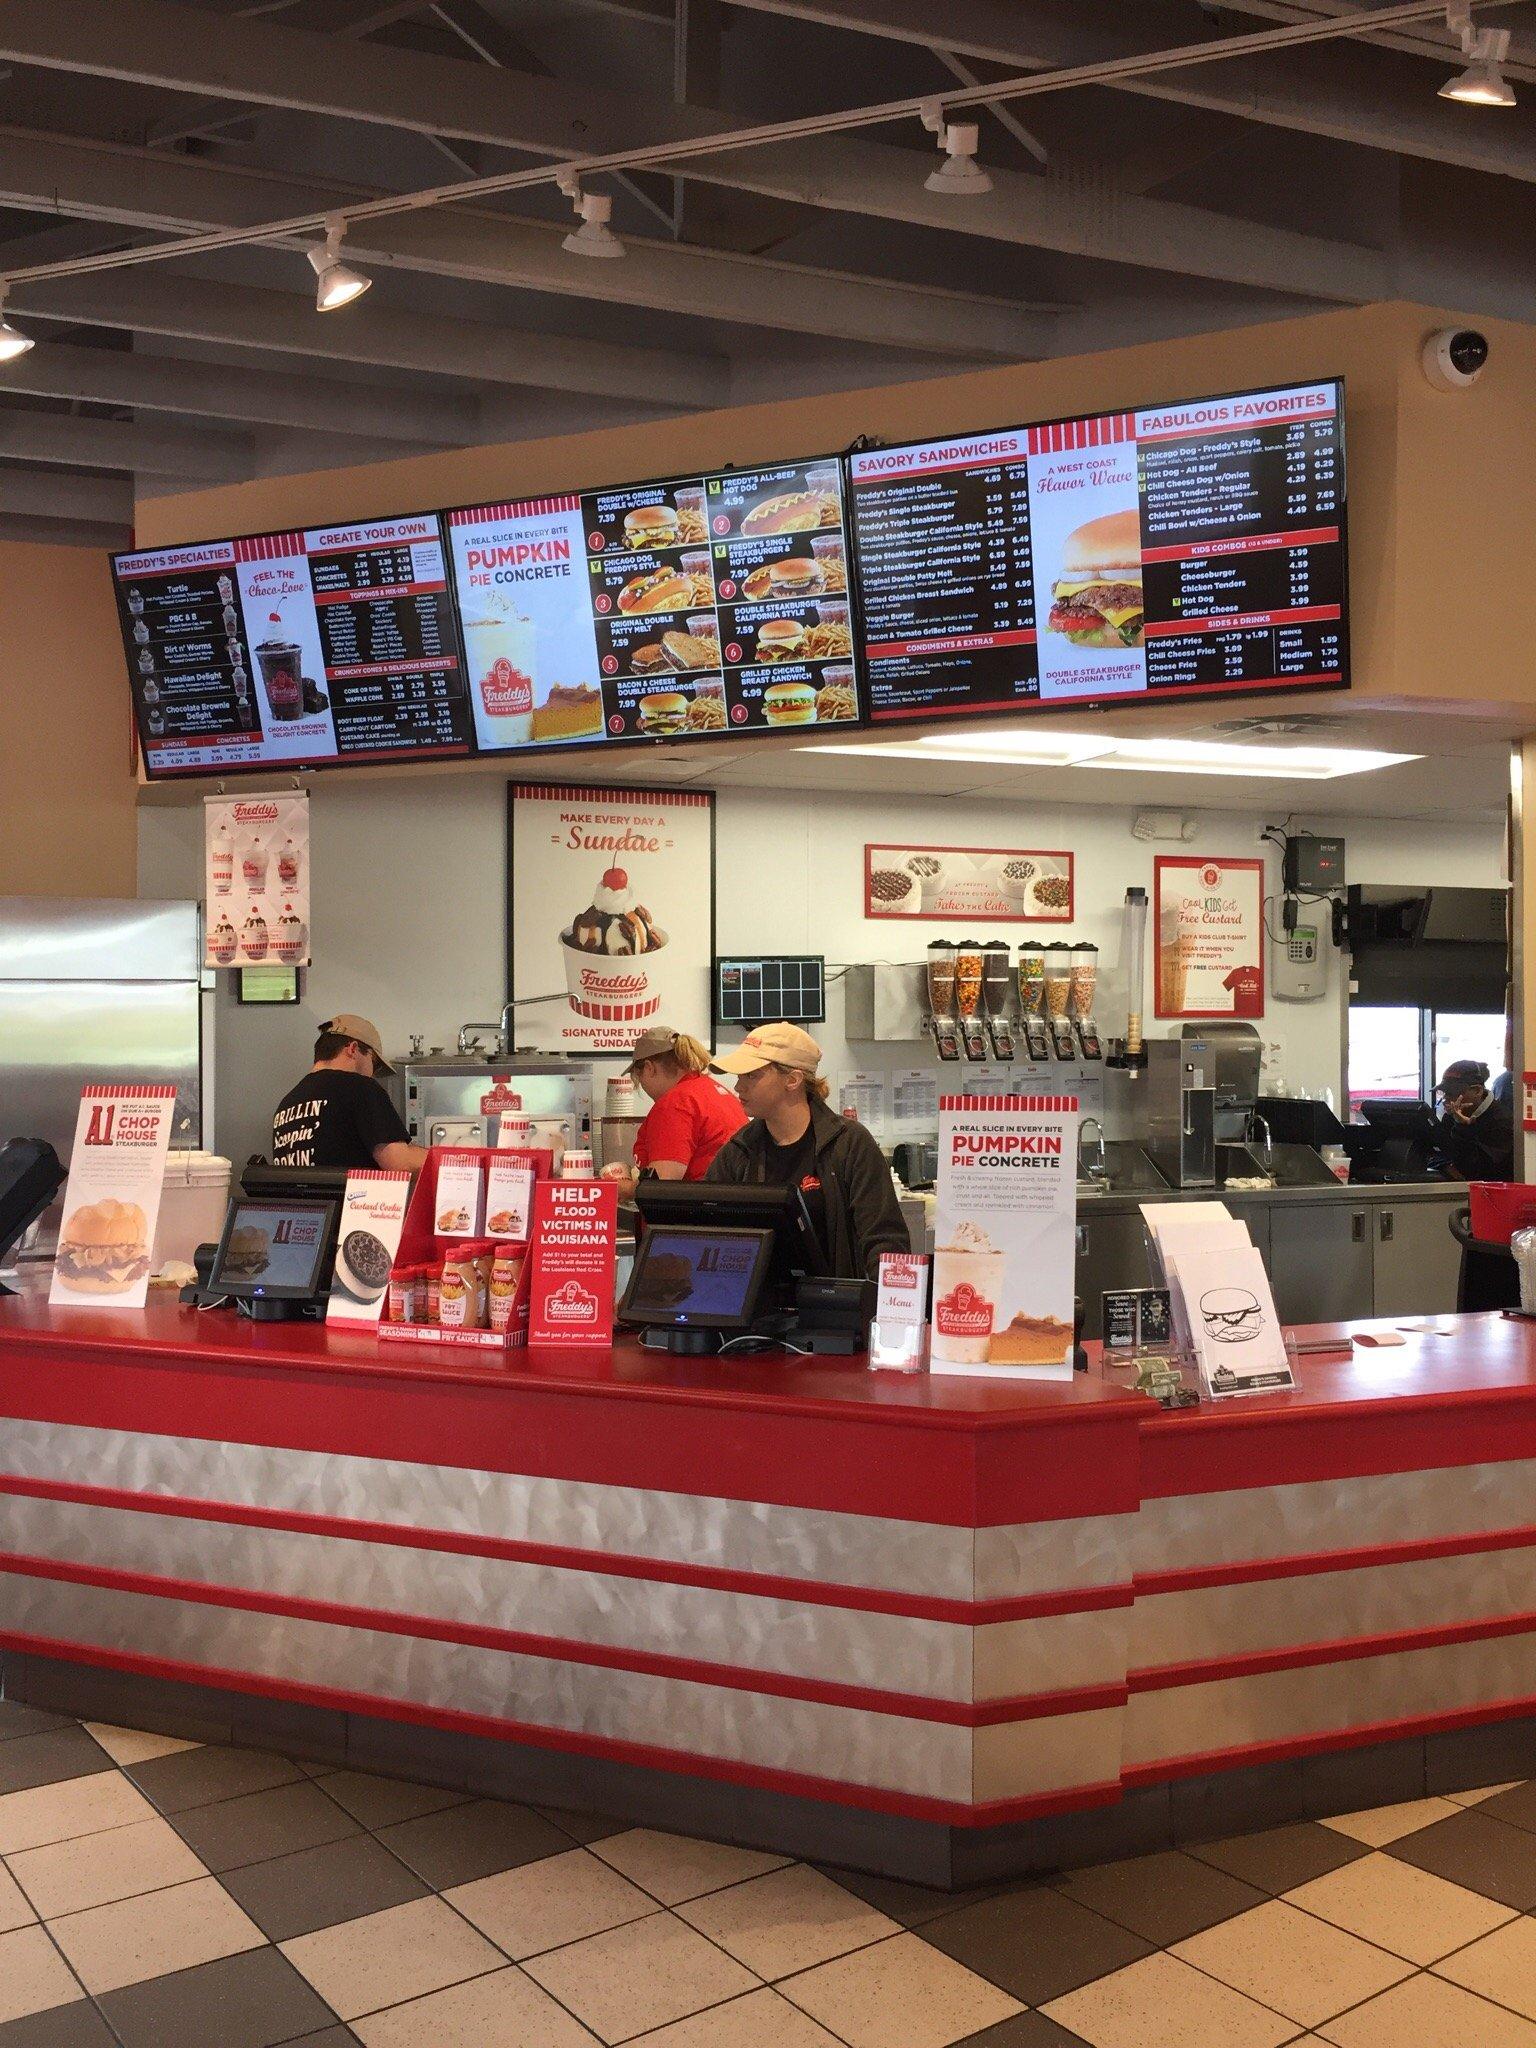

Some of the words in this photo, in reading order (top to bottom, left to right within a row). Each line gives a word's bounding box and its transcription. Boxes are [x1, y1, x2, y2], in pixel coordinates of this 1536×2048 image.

[1142, 406, 1229, 431] FABULOUS
[1234, 392, 1326, 417] FAVORITES
[858, 453, 914, 472] SAVORY
[918, 438, 1017, 464] SANDWICHES
[1057, 463, 1082, 473] WEST
[1086, 458, 1116, 469] COAST
[722, 476, 758, 487] FREDDY'S
[759, 470, 795, 482] ALL-BEEF
[1036, 473, 1084, 493] Flavor
[1089, 466, 1132, 486] Wave
[723, 486, 738, 494] HOT
[740, 483, 757, 492] DOG
[856, 490, 886, 501] Freddy's
[887, 486, 915, 496] Original
[916, 482, 941, 492] Double
[596, 493, 630, 504] FREDDY'S
[632, 489, 666, 500] ORIGINAL
[724, 496, 744, 506] 4.99
[597, 501, 626, 511] DOUBLE
[628, 496, 663, 508] w/CHEESE
[857, 509, 887, 520] Freddy's
[888, 506, 910, 516] Single
[911, 500, 955, 513] Steakburger
[319, 531, 362, 545] CREATE
[364, 526, 395, 539] YOUR
[398, 522, 426, 535] OWN
[471, 536, 490, 545] REAL
[492, 533, 513, 542] SLICE
[523, 528, 549, 538] EVERY
[550, 525, 568, 534] BITE
[118, 556, 165, 571] FREDDY'S
[167, 548, 230, 565] SPECIALTIES
[466, 538, 570, 571] PUMPKIN
[603, 556, 634, 566] CHICAGO
[635, 554, 652, 562] DOG
[604, 563, 637, 574] FREDDY'S
[639, 560, 661, 570] STYLE
[1180, 560, 1207, 569] Burger
[253, 571, 274, 583] FEEL
[276, 569, 295, 580] THE
[469, 573, 491, 587] PIE
[494, 563, 570, 584] CONCRETE
[605, 576, 623, 585] 5.79
[1181, 568, 1235, 582] Cheeseburger
[167, 584, 188, 593] Turtle
[248, 581, 305, 597] Choco-Love
[864, 596, 886, 605] Grilled
[888, 593, 915, 602] Chicken
[916, 590, 939, 599] Breast
[940, 586, 974, 596] Sandwich
[1181, 596, 1196, 605] Hot
[1197, 595, 1214, 604] Dog
[734, 605, 764, 615] DOUBLE
[766, 599, 820, 612] STEAKBURGER
[735, 611, 780, 622] CALIFORNIA
[781, 608, 805, 617] STYLE
[1208, 619, 1230, 628] SIDES
[1240, 615, 1270, 624] DRINKS
[735, 625, 753, 634] 7.59
[187, 642, 212, 651] Worms
[906, 641, 954, 652] CONDIMENTS
[963, 637, 993, 646] EXTRAS
[1280, 650, 1312, 659] Medium
[868, 657, 909, 666] Condiments
[1280, 663, 1303, 672] Large
[164, 674, 195, 684] Hawaiian
[196, 671, 221, 681] Delight
[740, 668, 770, 678] GRILLED
[772, 665, 805, 675] CHICKEN
[1046, 670, 1078, 679] DOUBLE
[1080, 664, 1140, 676] STEAKBURGER
[1149, 674, 1172, 683] Onion
[1174, 672, 1195, 682] Rings
[741, 676, 769, 685] BREAST
[771, 672, 812, 682] SANDWICH
[1055, 675, 1104, 685] CALIFORNIA
[1106, 672, 1132, 680] STYLE
[483, 682, 531, 703] Freddy's
[871, 684, 892, 692] Extras
[165, 704, 200, 713] Chocolate
[201, 701, 229, 710] Brownie
[186, 711, 212, 720] Delight
[267, 724, 300, 732] CHOCOLATE
[301, 721, 327, 729] BROWNIE
[232, 803, 278, 820] Freddy's
[560, 814, 591, 823] MAKE
[595, 816, 630, 824] EVERY
[634, 817, 655, 825] DAY
[658, 818, 665, 826] A
[566, 826, 660, 851] Sundae
[1205, 898, 1221, 912] KIDS
[1177, 912, 1198, 923] Free
[1203, 912, 1242, 923] Custard
[580, 969, 648, 991] Freddy's
[562, 1029, 624, 1037] SIGNATURE
[483, 1099, 519, 1110] Freddy's
[274, 1100, 327, 1129] GRILLIN'
[119, 1117, 160, 1128] CHOP
[117, 1131, 157, 1140] HOUSE
[952, 1136, 1062, 1154] PUMPKIN
[952, 1156, 974, 1166] PIE
[979, 1156, 1060, 1168] CONCRETE
[551, 1188, 602, 1202] HELP
[350, 1201, 377, 1210] Custard
[554, 1207, 596, 1216] FLOOD
[542, 1221, 592, 1230] VICTIMS
[595, 1221, 608, 1230] IN
[541, 1235, 608, 1244] LOUISIANA
[883, 1270, 917, 1284] Freddy's
[549, 1300, 593, 1314] Freddy's
[886, 1296, 912, 1308] Menu
[939, 1306, 990, 1329] Freddy's
